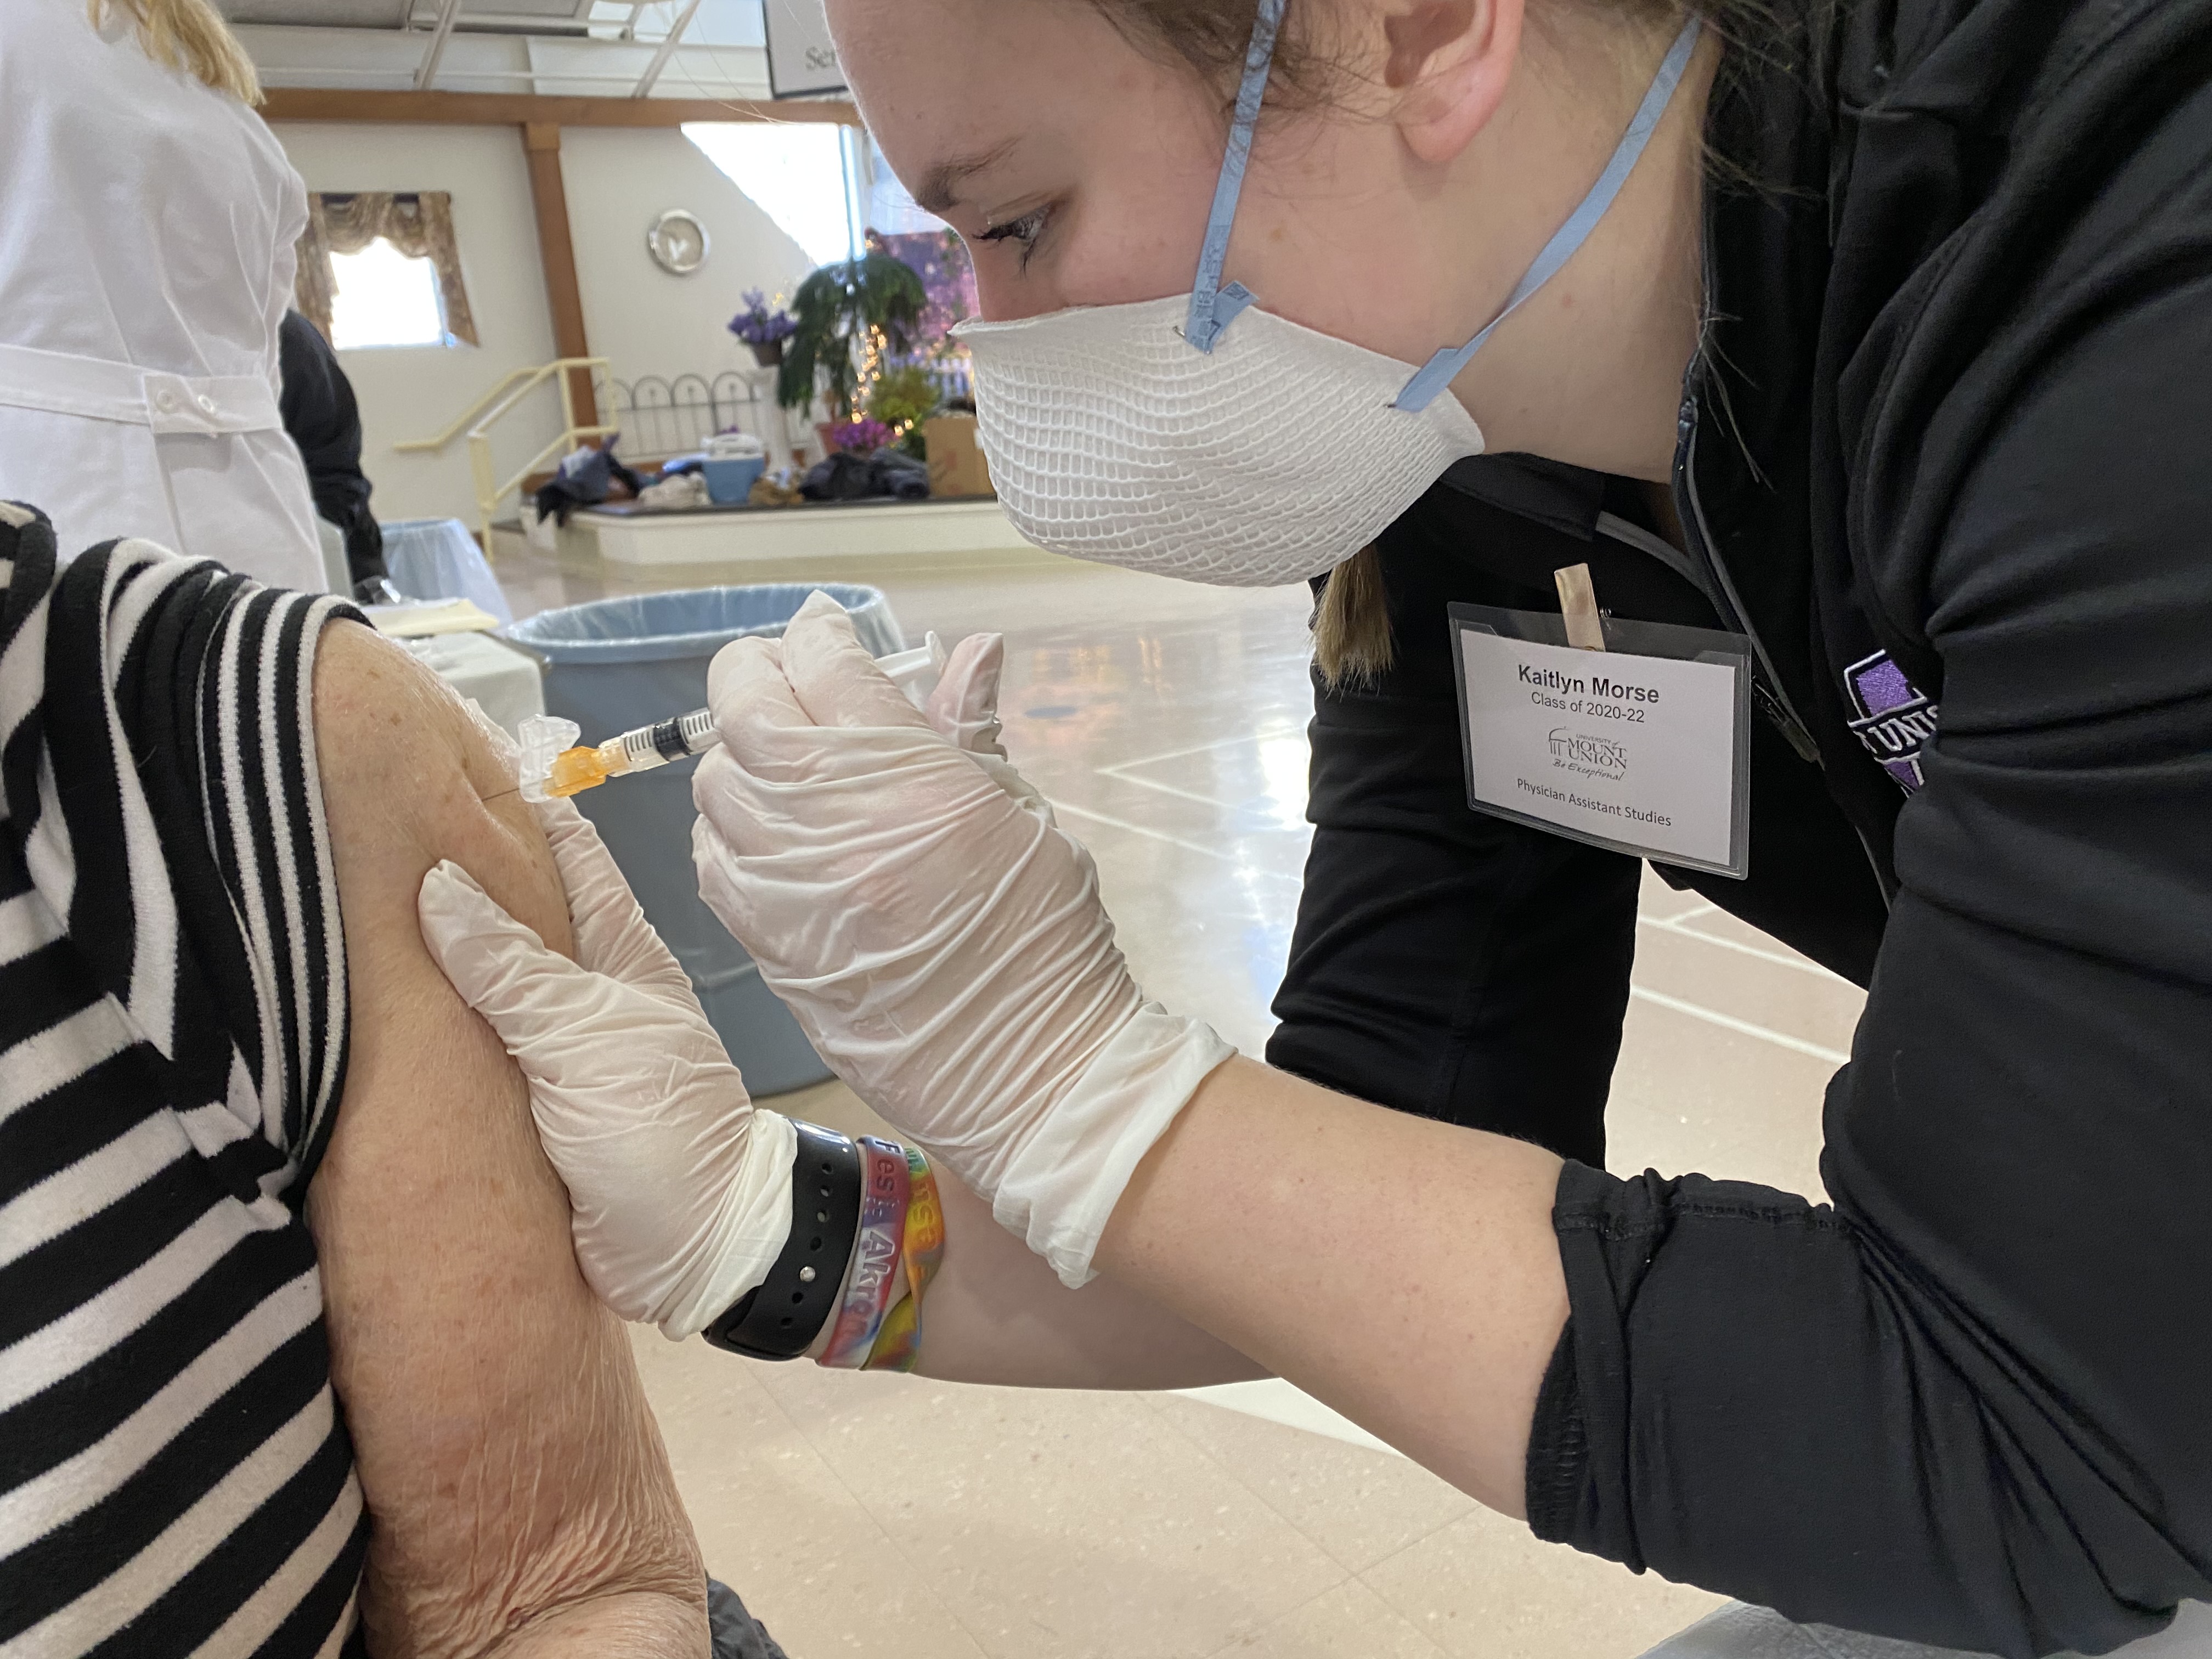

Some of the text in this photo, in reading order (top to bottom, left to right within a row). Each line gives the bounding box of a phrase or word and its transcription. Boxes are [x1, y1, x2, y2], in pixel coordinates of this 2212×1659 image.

[1519, 664, 1659, 703] Kaitlyn Morse
[1531, 691, 1645, 723] Class of 2020-22
[1567, 737, 1627, 758] MOUNT
[1576, 733, 1611, 744] UNIVERSITY
[1553, 758, 1624, 781] Be Exceptional
[1568, 748, 1627, 769] UNION
[1517, 778, 1672, 826] Physician Assistant Studies
[845, 1231, 894, 1337] Akron
